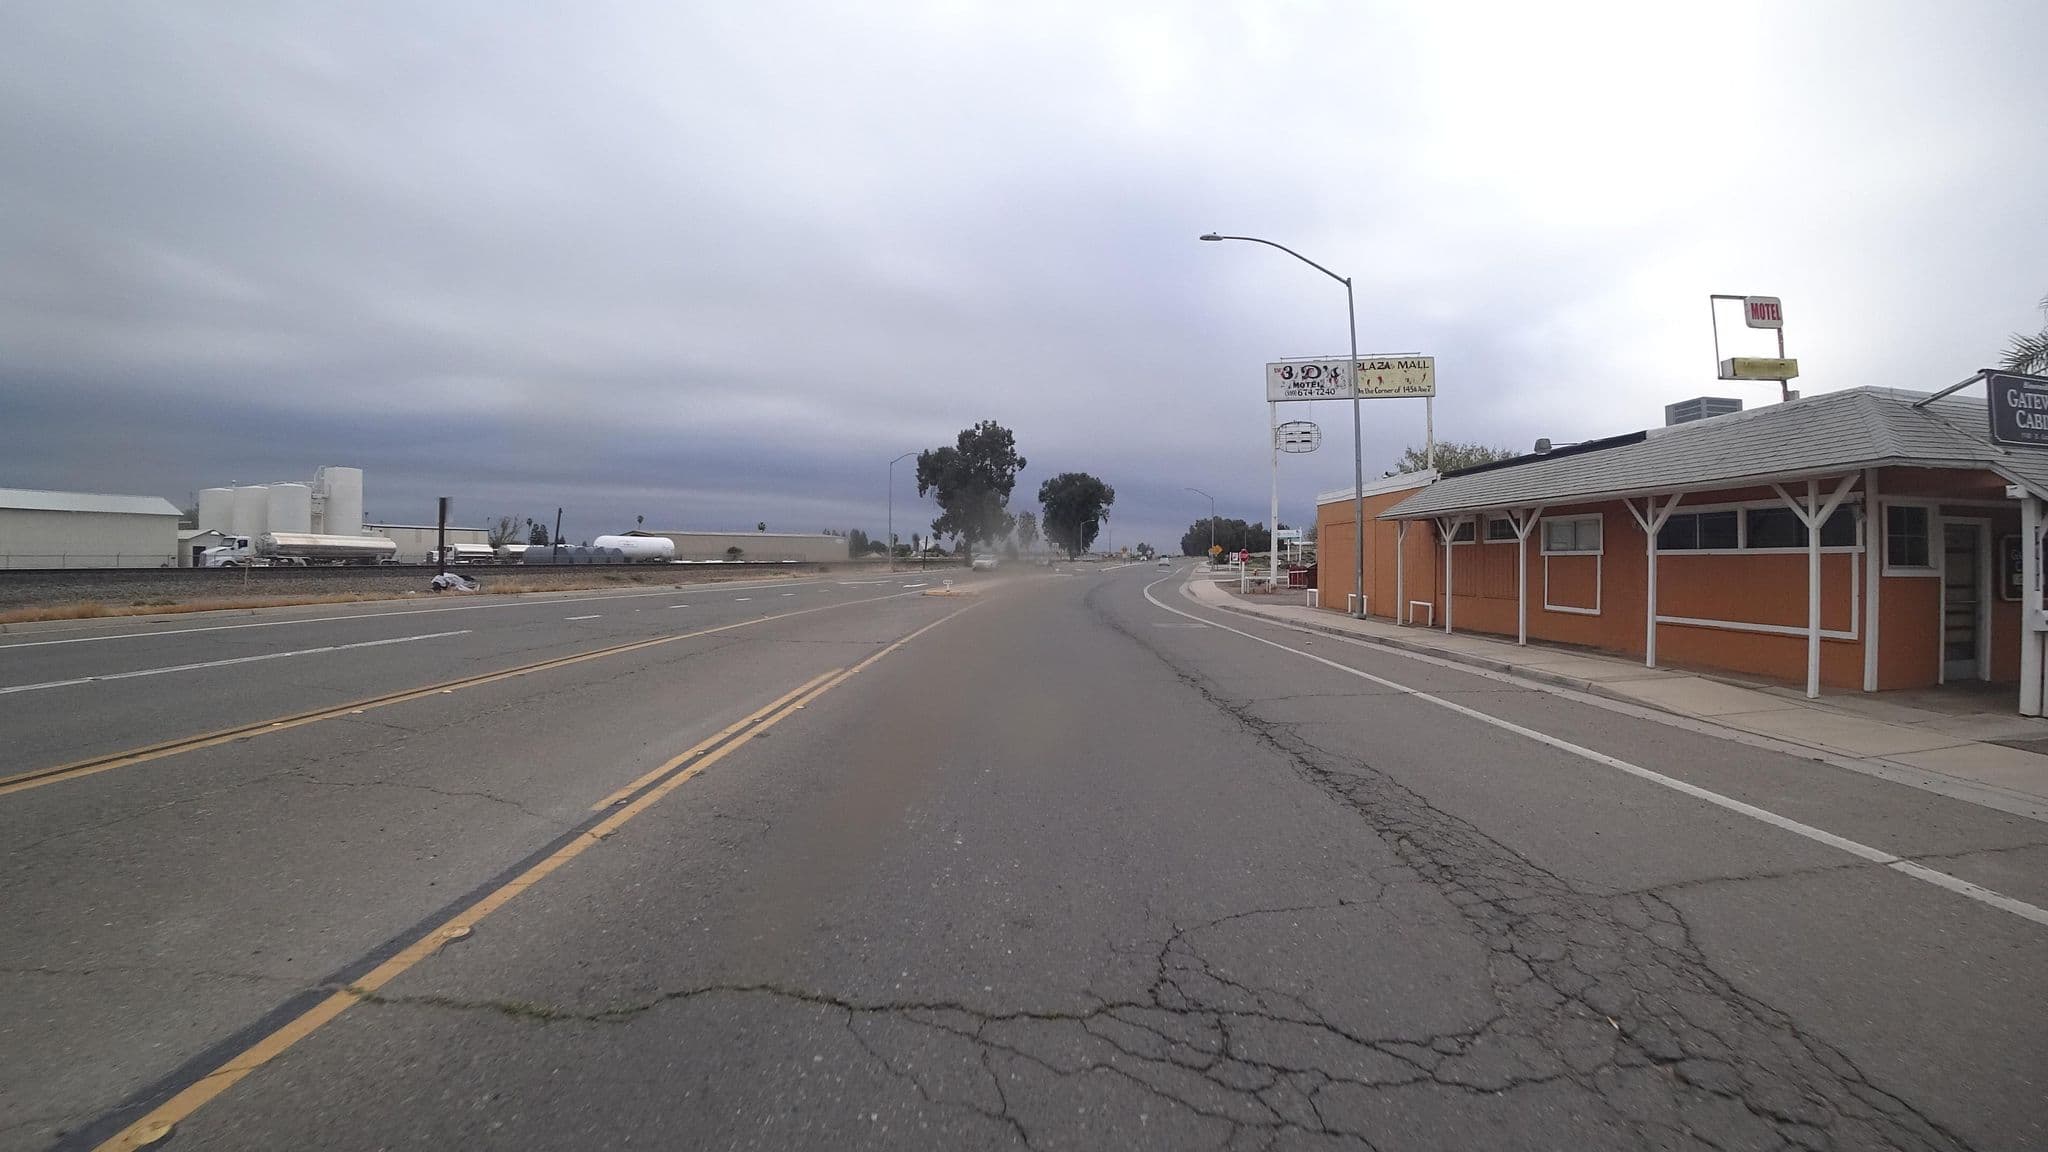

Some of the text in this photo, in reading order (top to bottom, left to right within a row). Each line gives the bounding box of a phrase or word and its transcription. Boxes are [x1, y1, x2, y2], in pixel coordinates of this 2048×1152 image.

[1750, 303, 1781, 320] MOTEL
[1356, 360, 1429, 370] PLAZA MALL
[1374, 386, 1393, 394] Corner
